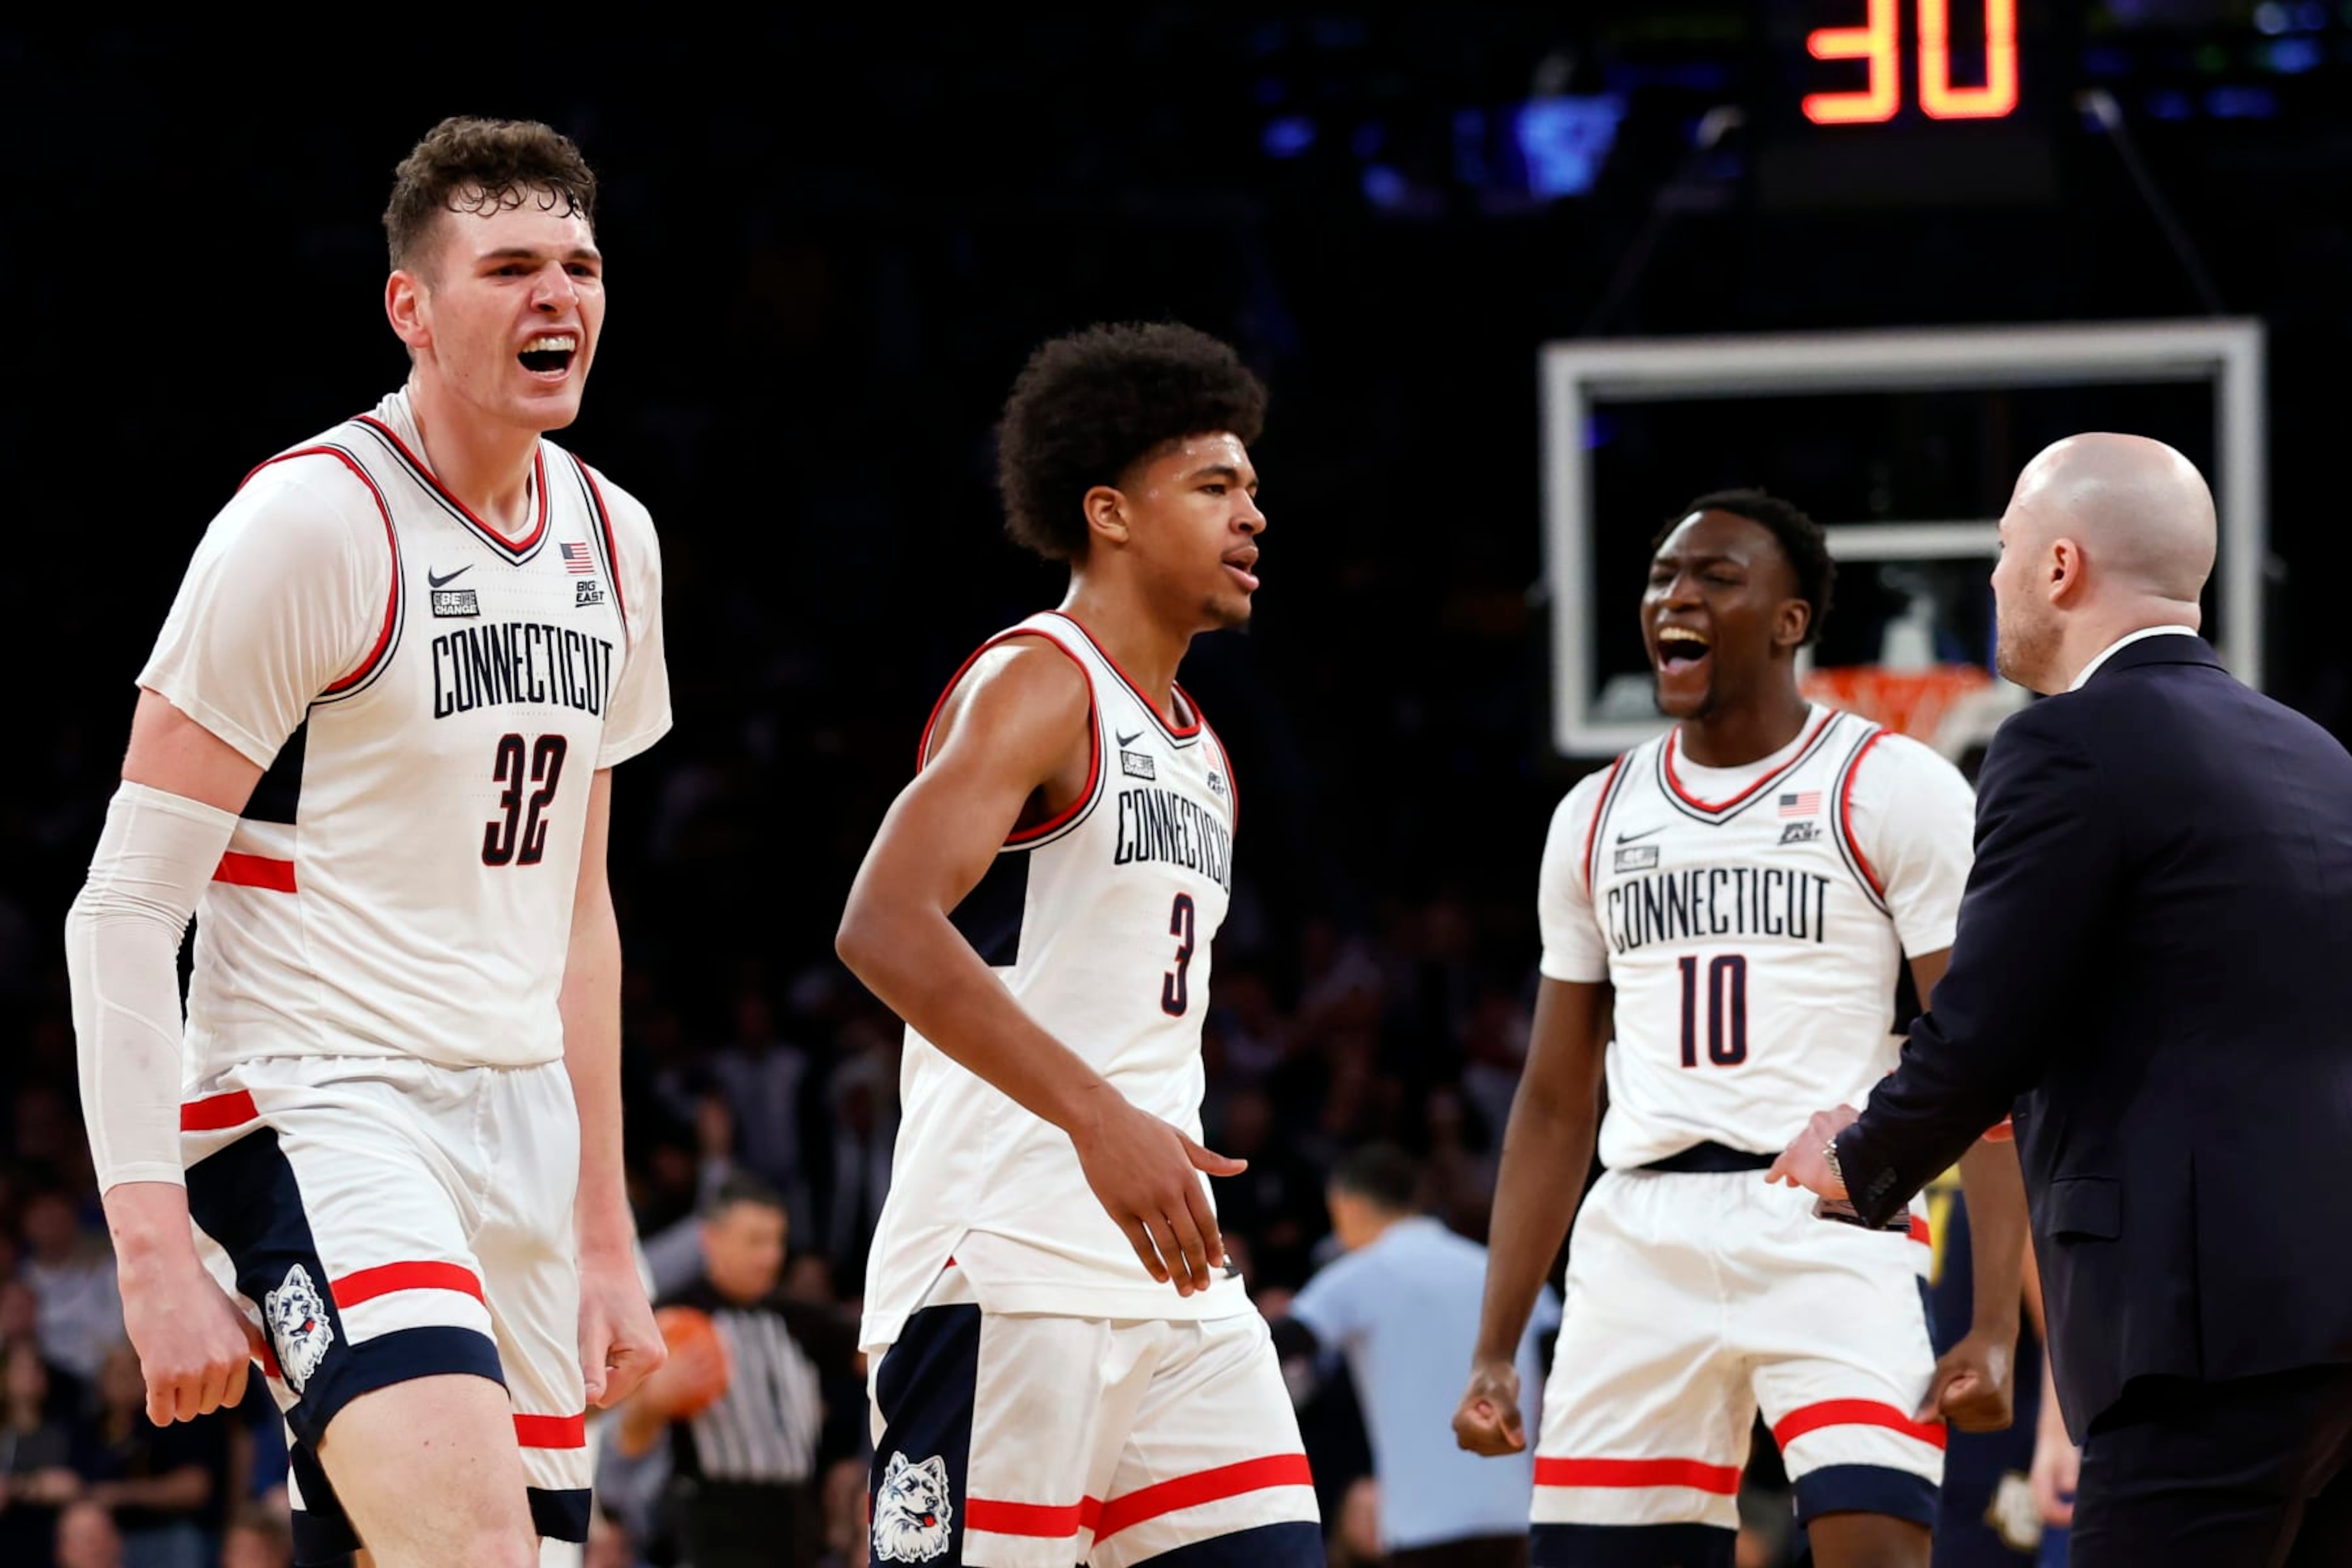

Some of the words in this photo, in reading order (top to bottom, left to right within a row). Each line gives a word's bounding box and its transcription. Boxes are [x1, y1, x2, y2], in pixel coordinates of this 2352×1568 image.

[1801, 0, 2018, 124] 30
[434, 605, 478, 615] CHANGE
[576, 591, 605, 602] EAST
[577, 581, 595, 592] BIG
[432, 622, 612, 720] CONNECTICUT
[481, 733, 568, 866] 32
[1161, 891, 1194, 1017] 3
[1607, 867, 1830, 955] CONNECTICUT
[1678, 954, 1747, 1068] 10
